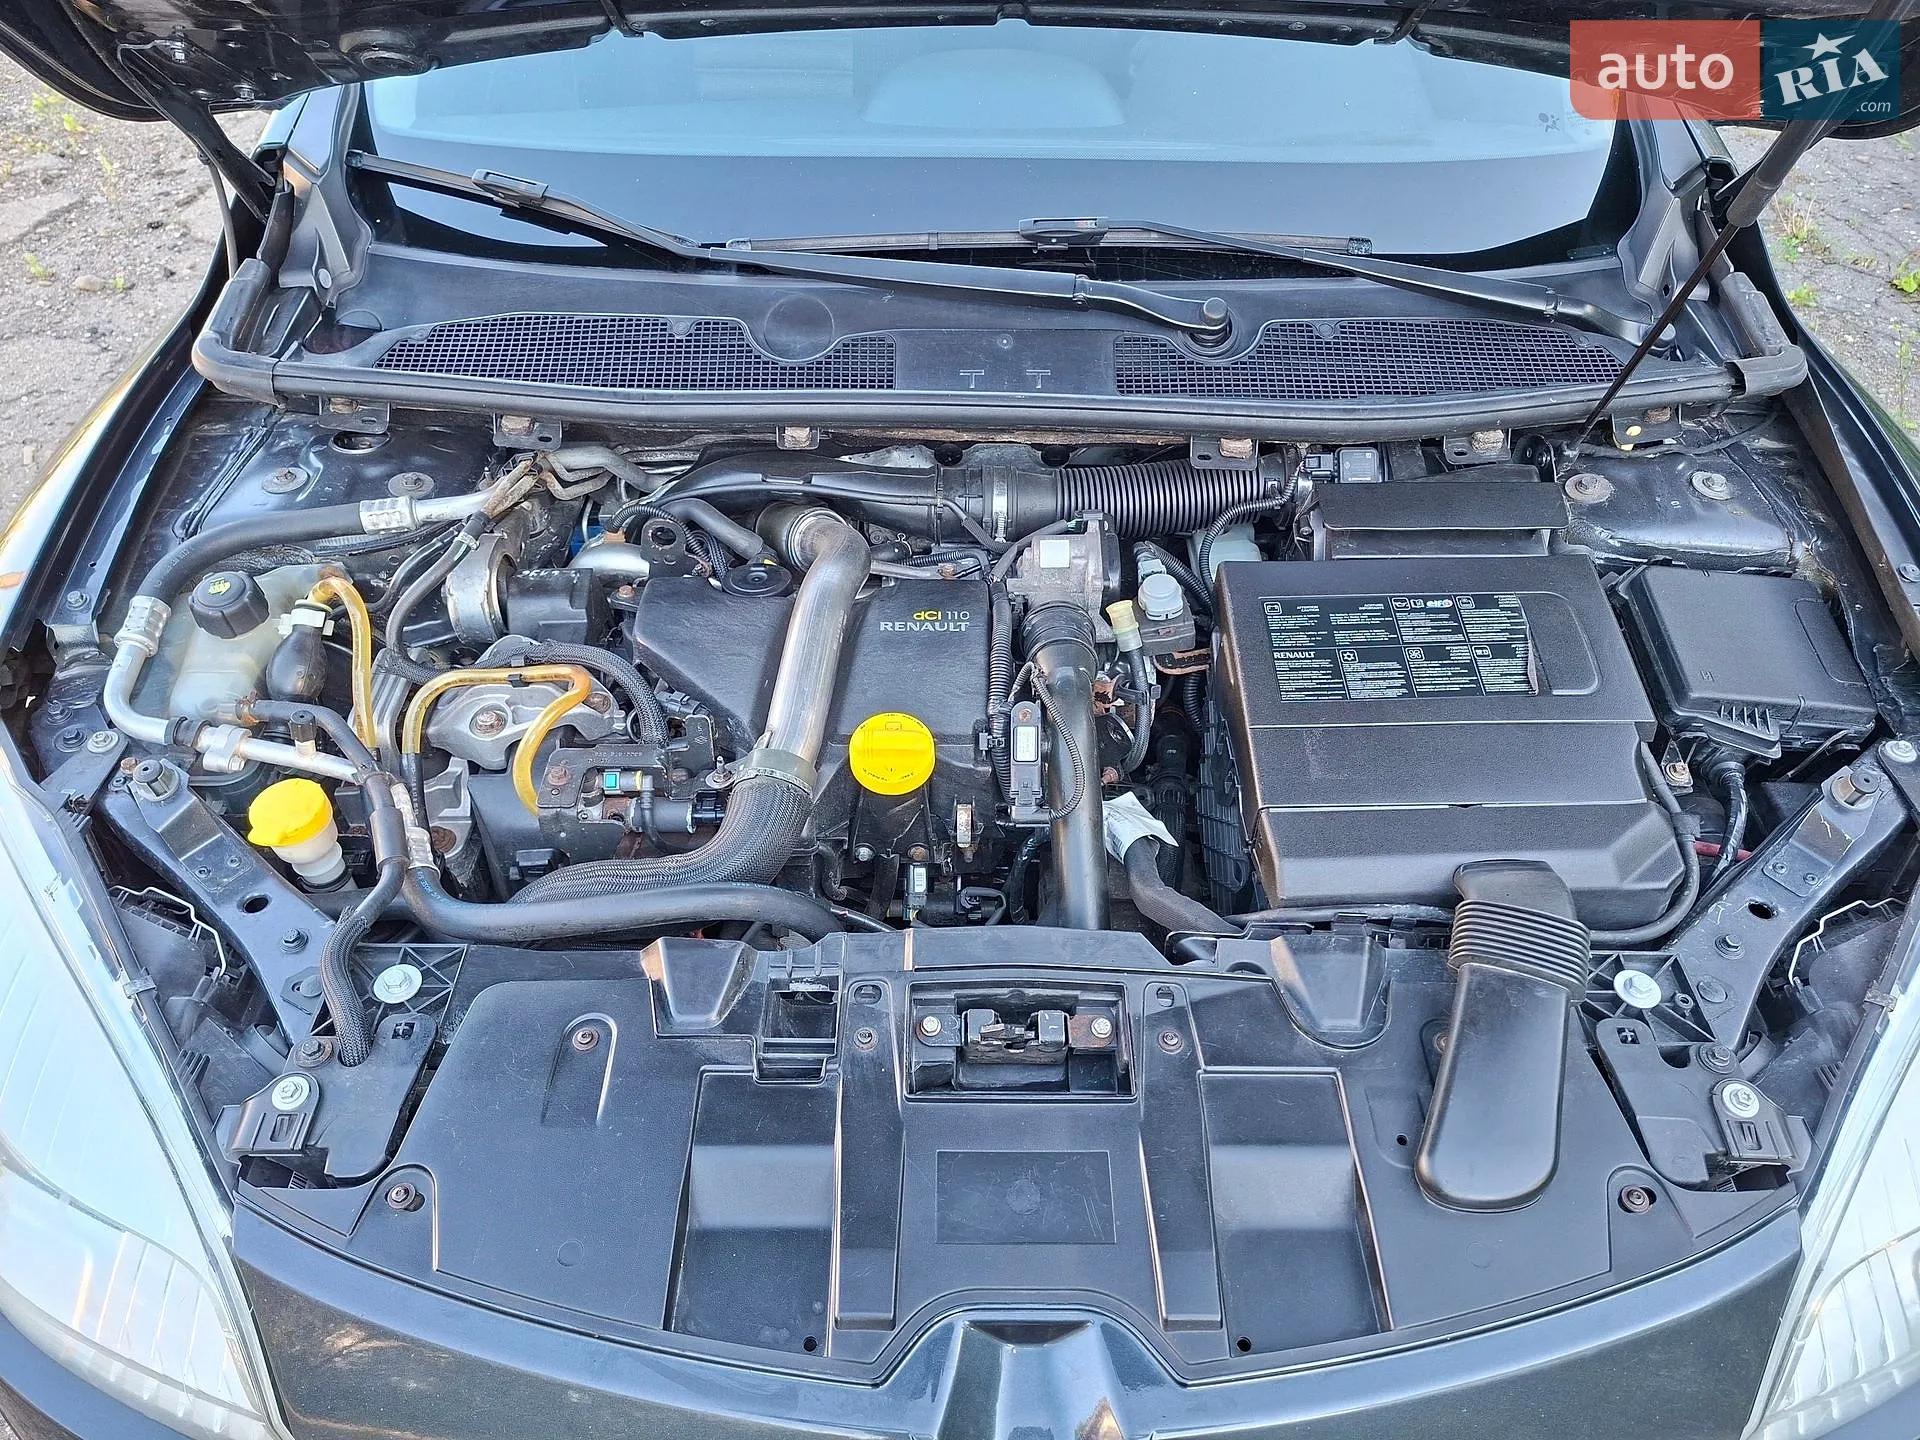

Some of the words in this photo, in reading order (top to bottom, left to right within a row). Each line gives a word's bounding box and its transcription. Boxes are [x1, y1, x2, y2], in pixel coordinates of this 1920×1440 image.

[946, 610, 970, 620] 110
[880, 621, 970, 632] RENAULT
[1273, 651, 1316, 659] RENAULT
